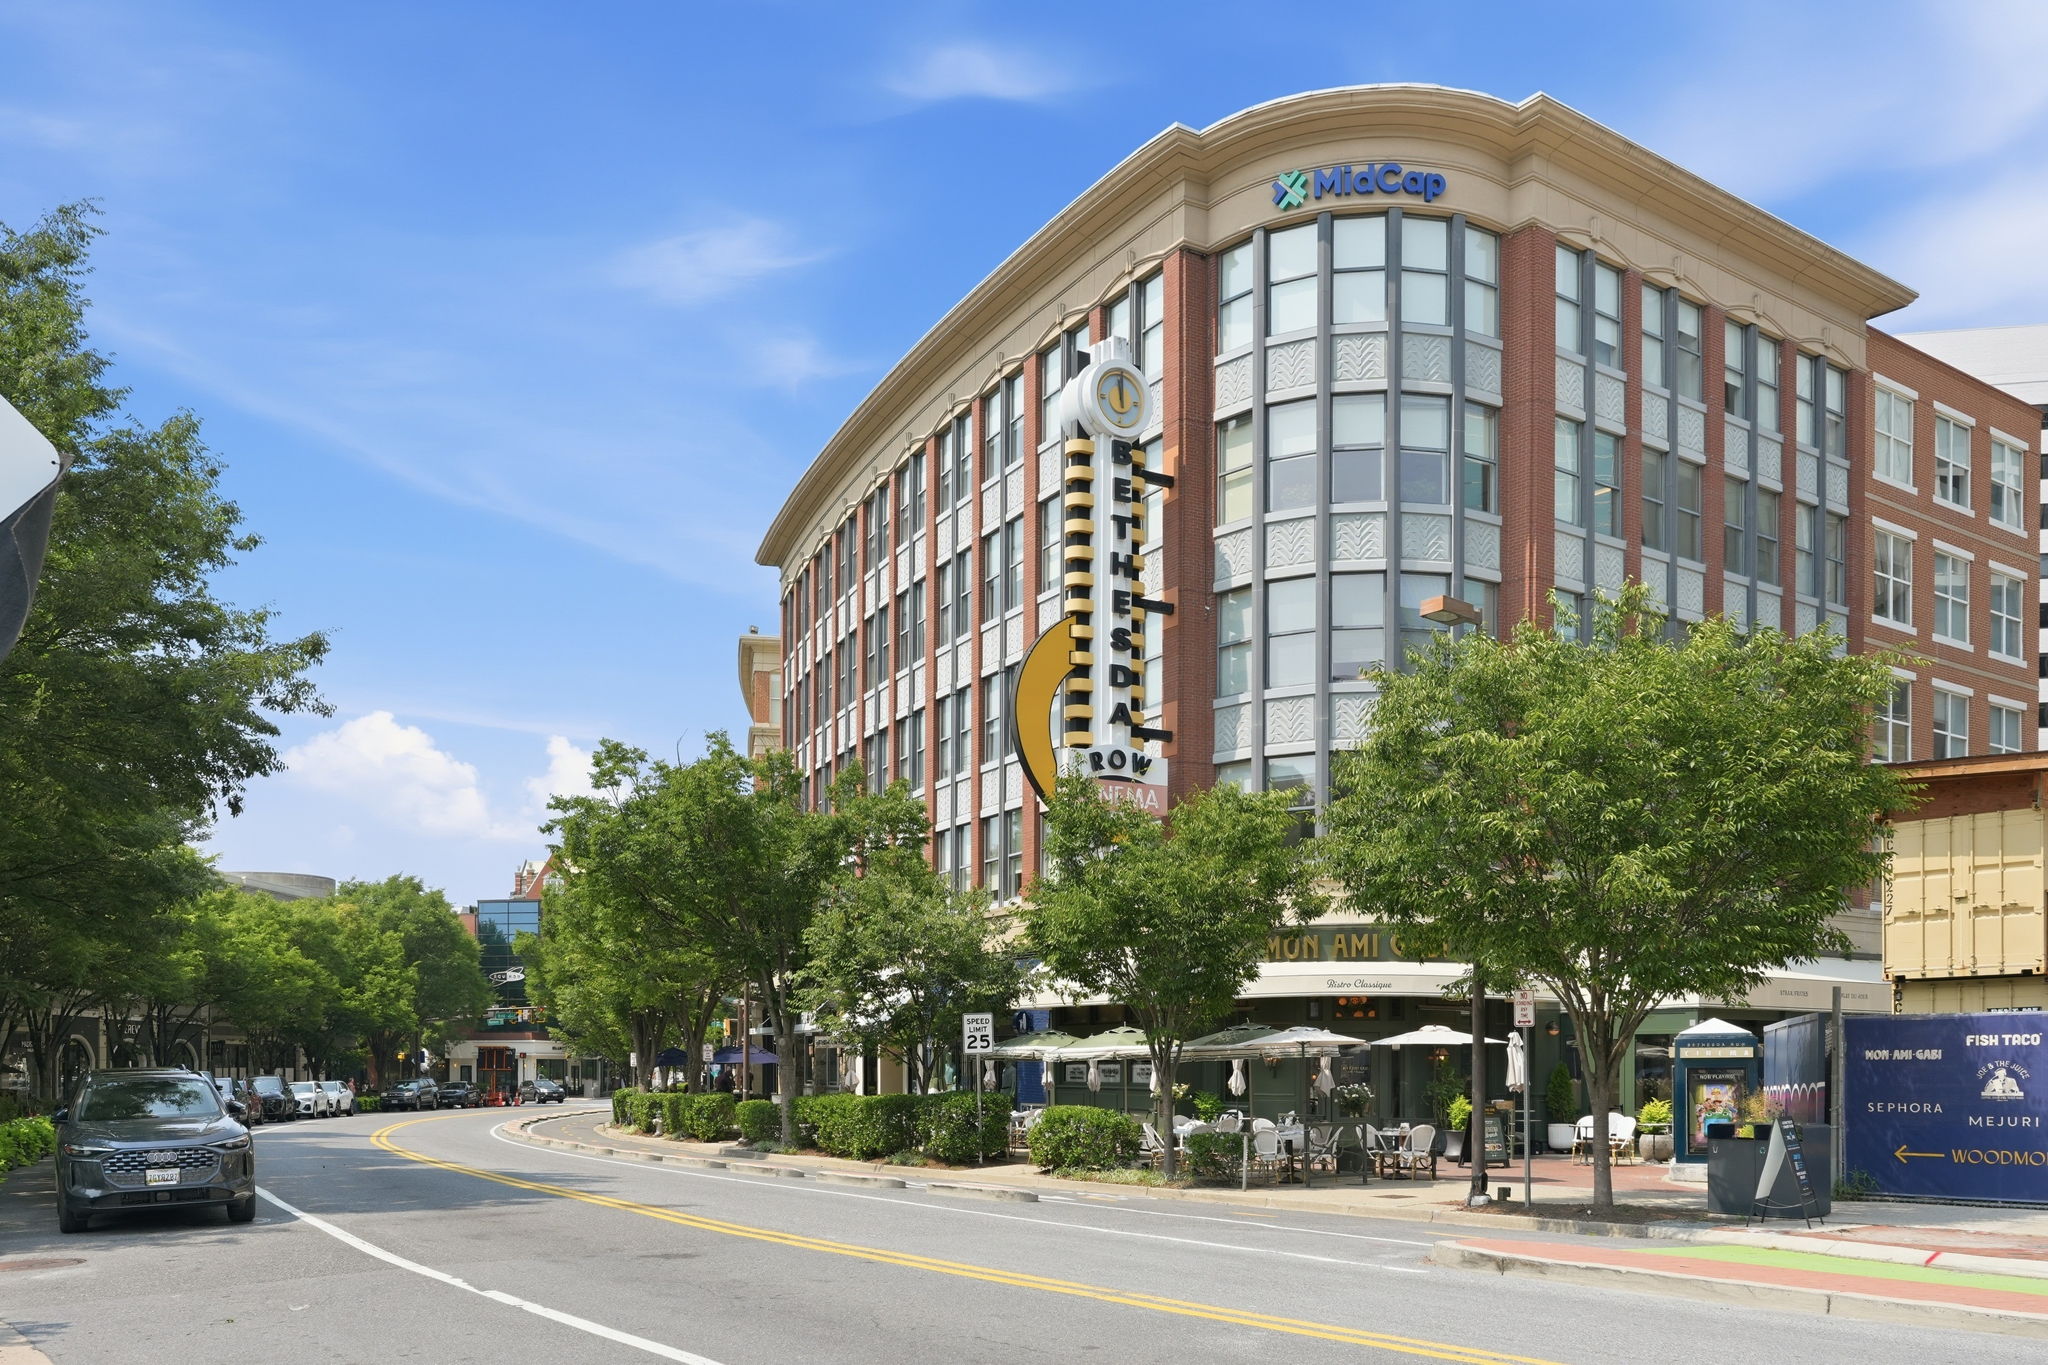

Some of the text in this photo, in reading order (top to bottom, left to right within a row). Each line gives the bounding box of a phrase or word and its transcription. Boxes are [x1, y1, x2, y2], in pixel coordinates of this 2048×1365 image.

[1314, 163, 1446, 202] MidCap
[1109, 439, 1134, 727] BETHESDA
[1089, 749, 1152, 776] ROW
[1265, 934, 1320, 961] MON
[1331, 933, 1380, 959] AMI
[1326, 978, 1393, 990] Bistro Classique
[1520, 991, 1528, 1000] NO
[967, 1034, 990, 1049] 25
[1965, 1033, 2041, 1047] FISH TACO
[1976, 1060, 2031, 1080] JOE & THE JUICE
[1867, 1102, 1943, 1113] SEPHORA
[1968, 1116, 2040, 1128] MEJURI
[1952, 1149, 2048, 1166] WOODMO
